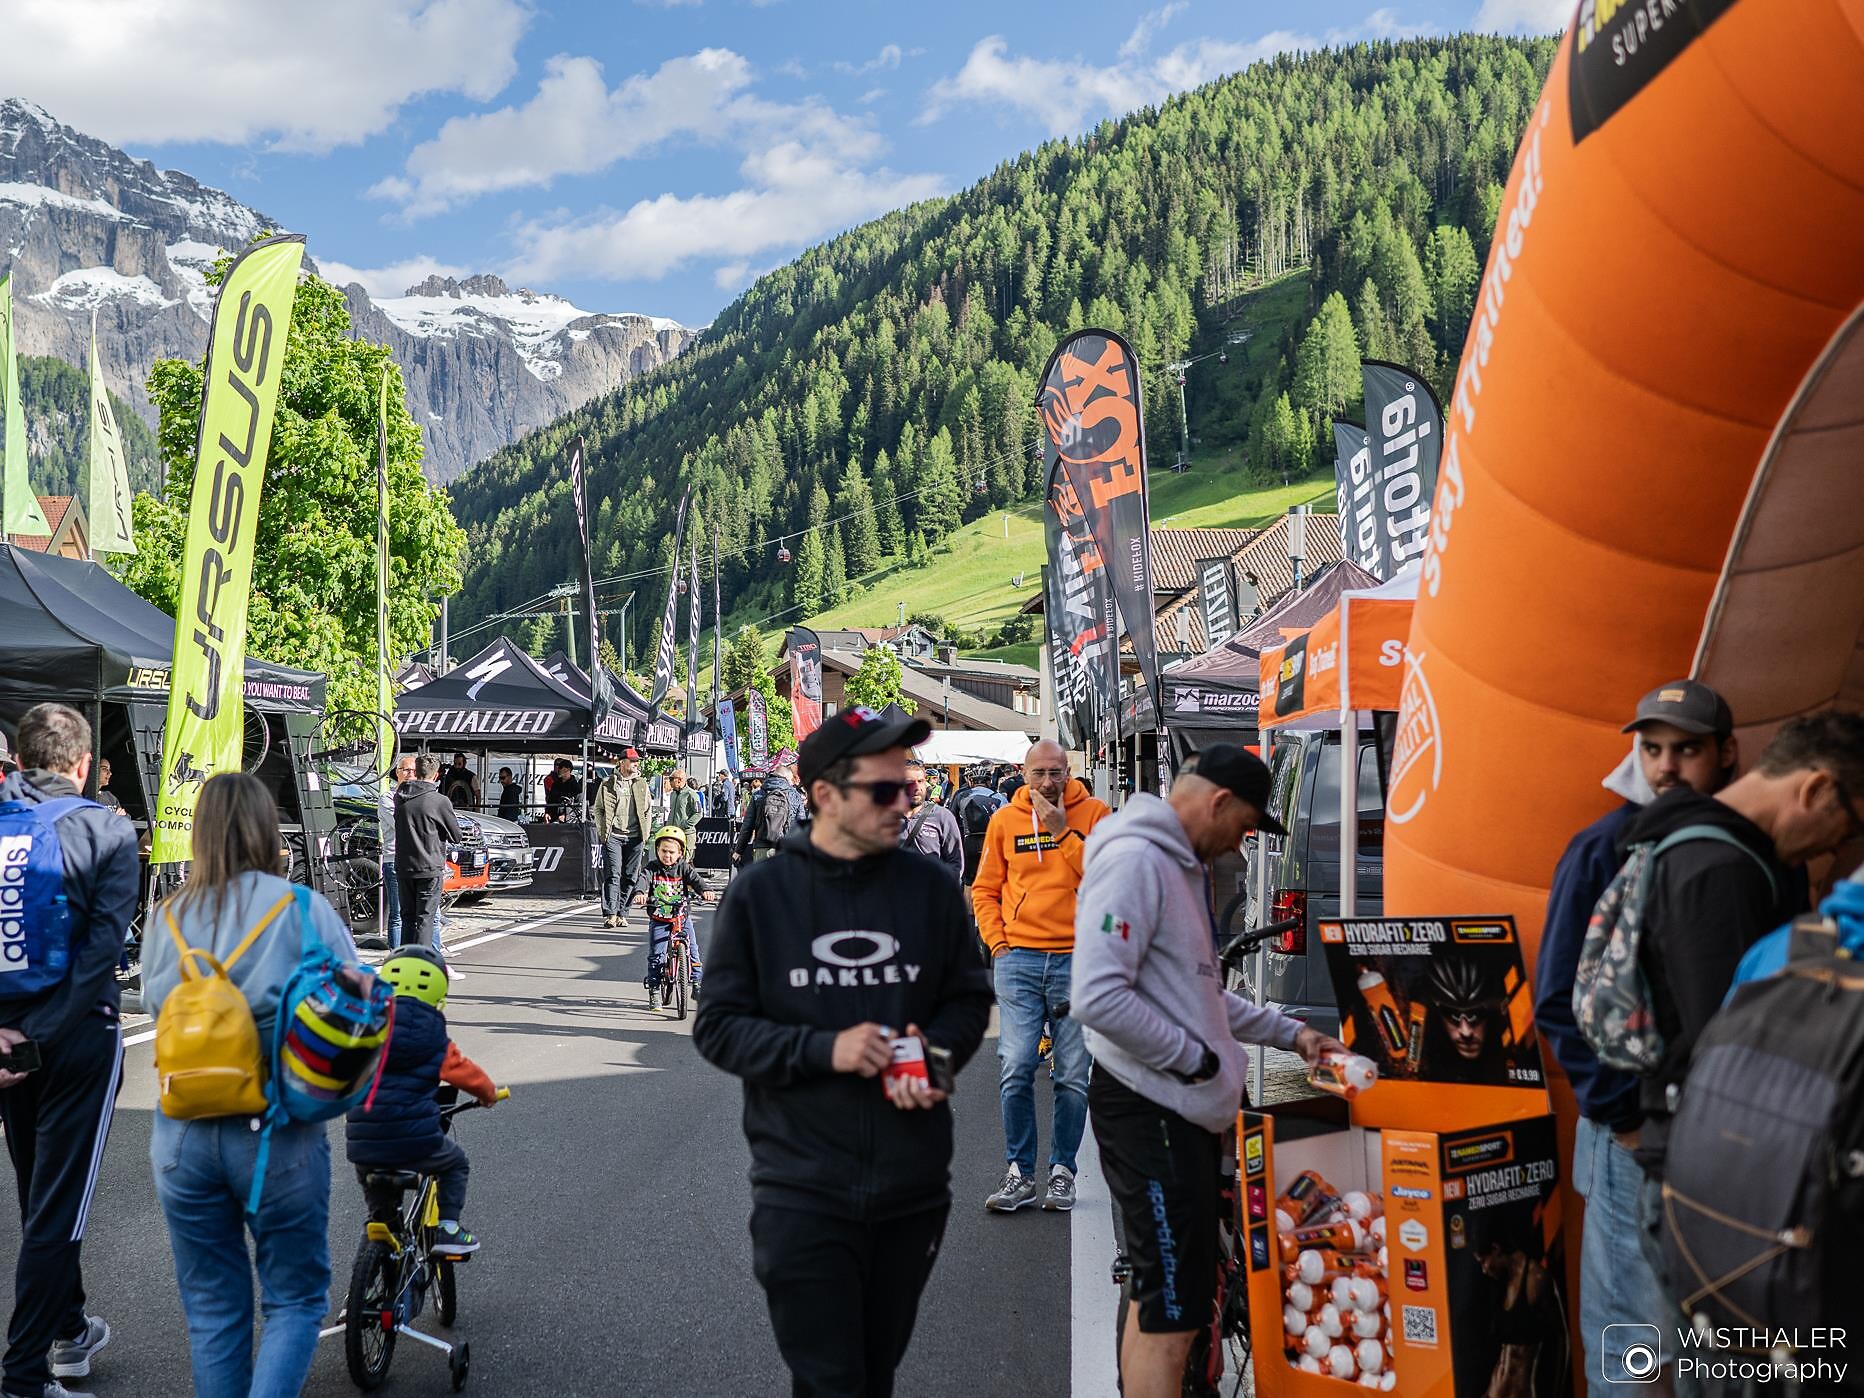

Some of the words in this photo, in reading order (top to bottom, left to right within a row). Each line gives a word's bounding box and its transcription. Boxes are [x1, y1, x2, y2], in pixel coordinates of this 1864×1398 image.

[187, 290, 272, 720] URSUS
[1423, 432, 1465, 597] Stay
[247, 681, 262, 697] YOU
[262, 682, 283, 699] WANT
[283, 685, 293, 700] TO
[393, 711, 556, 734] SPECIALIZED
[0, 847, 29, 963] adidas
[1344, 922, 1406, 943] HYDRAFIT
[1409, 921, 1447, 943] ZERO
[789, 964, 921, 988] OAKLEY
[1443, 1180, 1461, 1200] NEW
[1466, 1164, 1522, 1197] HYDRAFIT
[1525, 1158, 1555, 1183] ZERO
[1485, 1189, 1509, 1207] SUGAR
